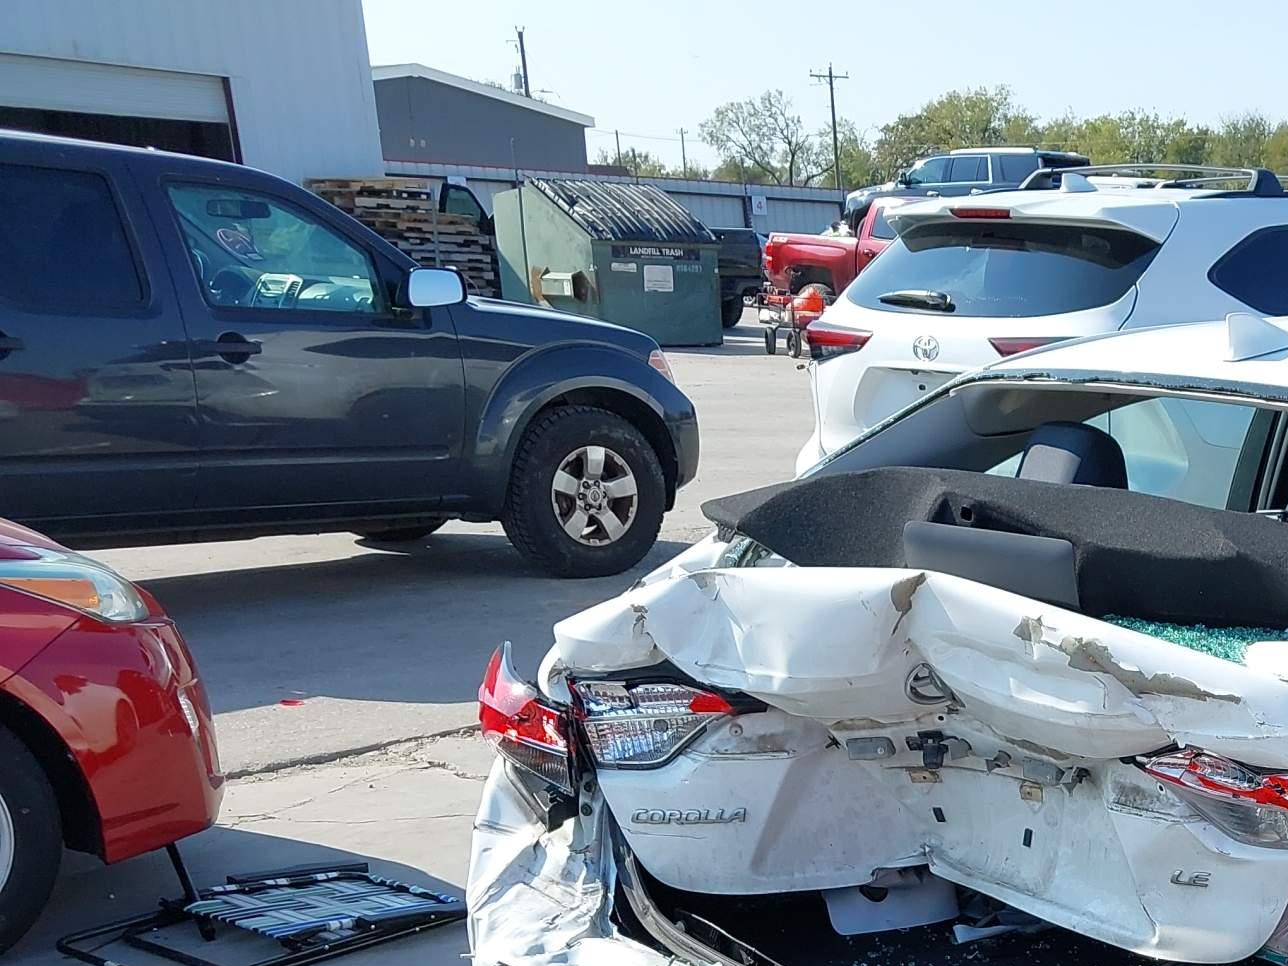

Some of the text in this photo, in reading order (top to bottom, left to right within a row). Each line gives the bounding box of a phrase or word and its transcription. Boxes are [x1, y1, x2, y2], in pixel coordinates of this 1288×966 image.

[629, 247, 684, 257] LANDFILL TRASH
[631, 808, 746, 825] COROLLA
[1170, 869, 1211, 887] LE
